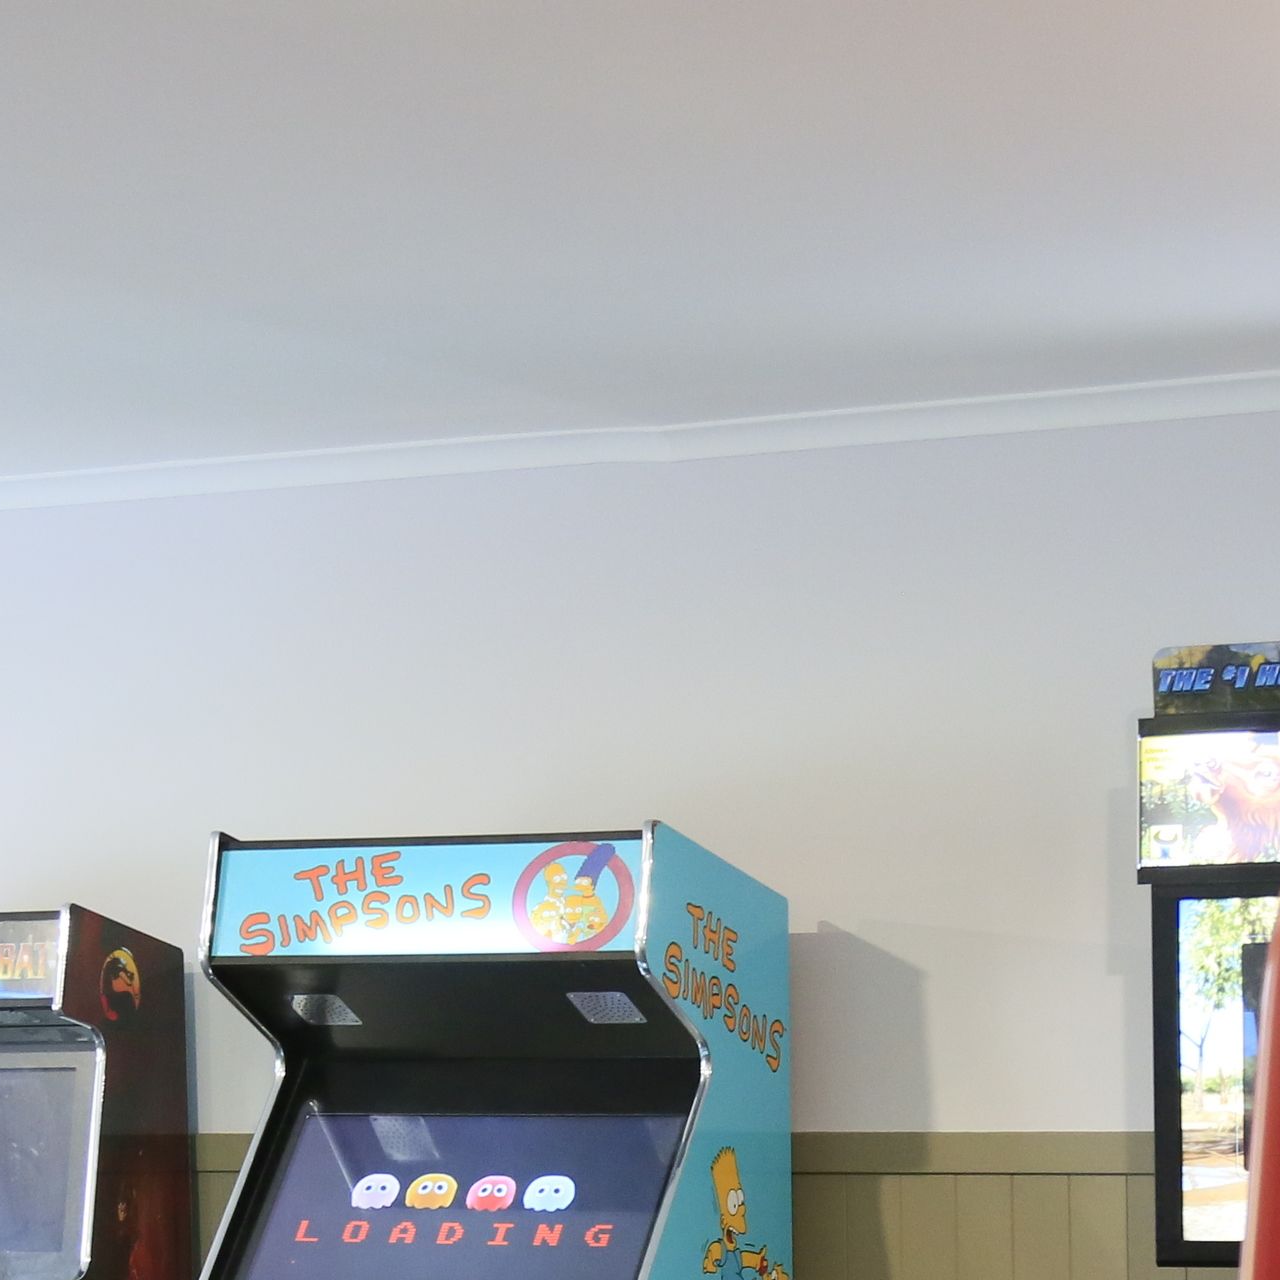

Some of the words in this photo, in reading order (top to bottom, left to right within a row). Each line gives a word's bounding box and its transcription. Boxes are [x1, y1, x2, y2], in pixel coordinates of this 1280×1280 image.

[1158, 668, 1214, 692] THE
[294, 851, 404, 902] THE
[239, 873, 491, 956] SIMPSONS
[686, 902, 738, 973] THE
[662, 941, 785, 1073] SIMPSONS
[294, 1219, 615, 1248] LOADING
